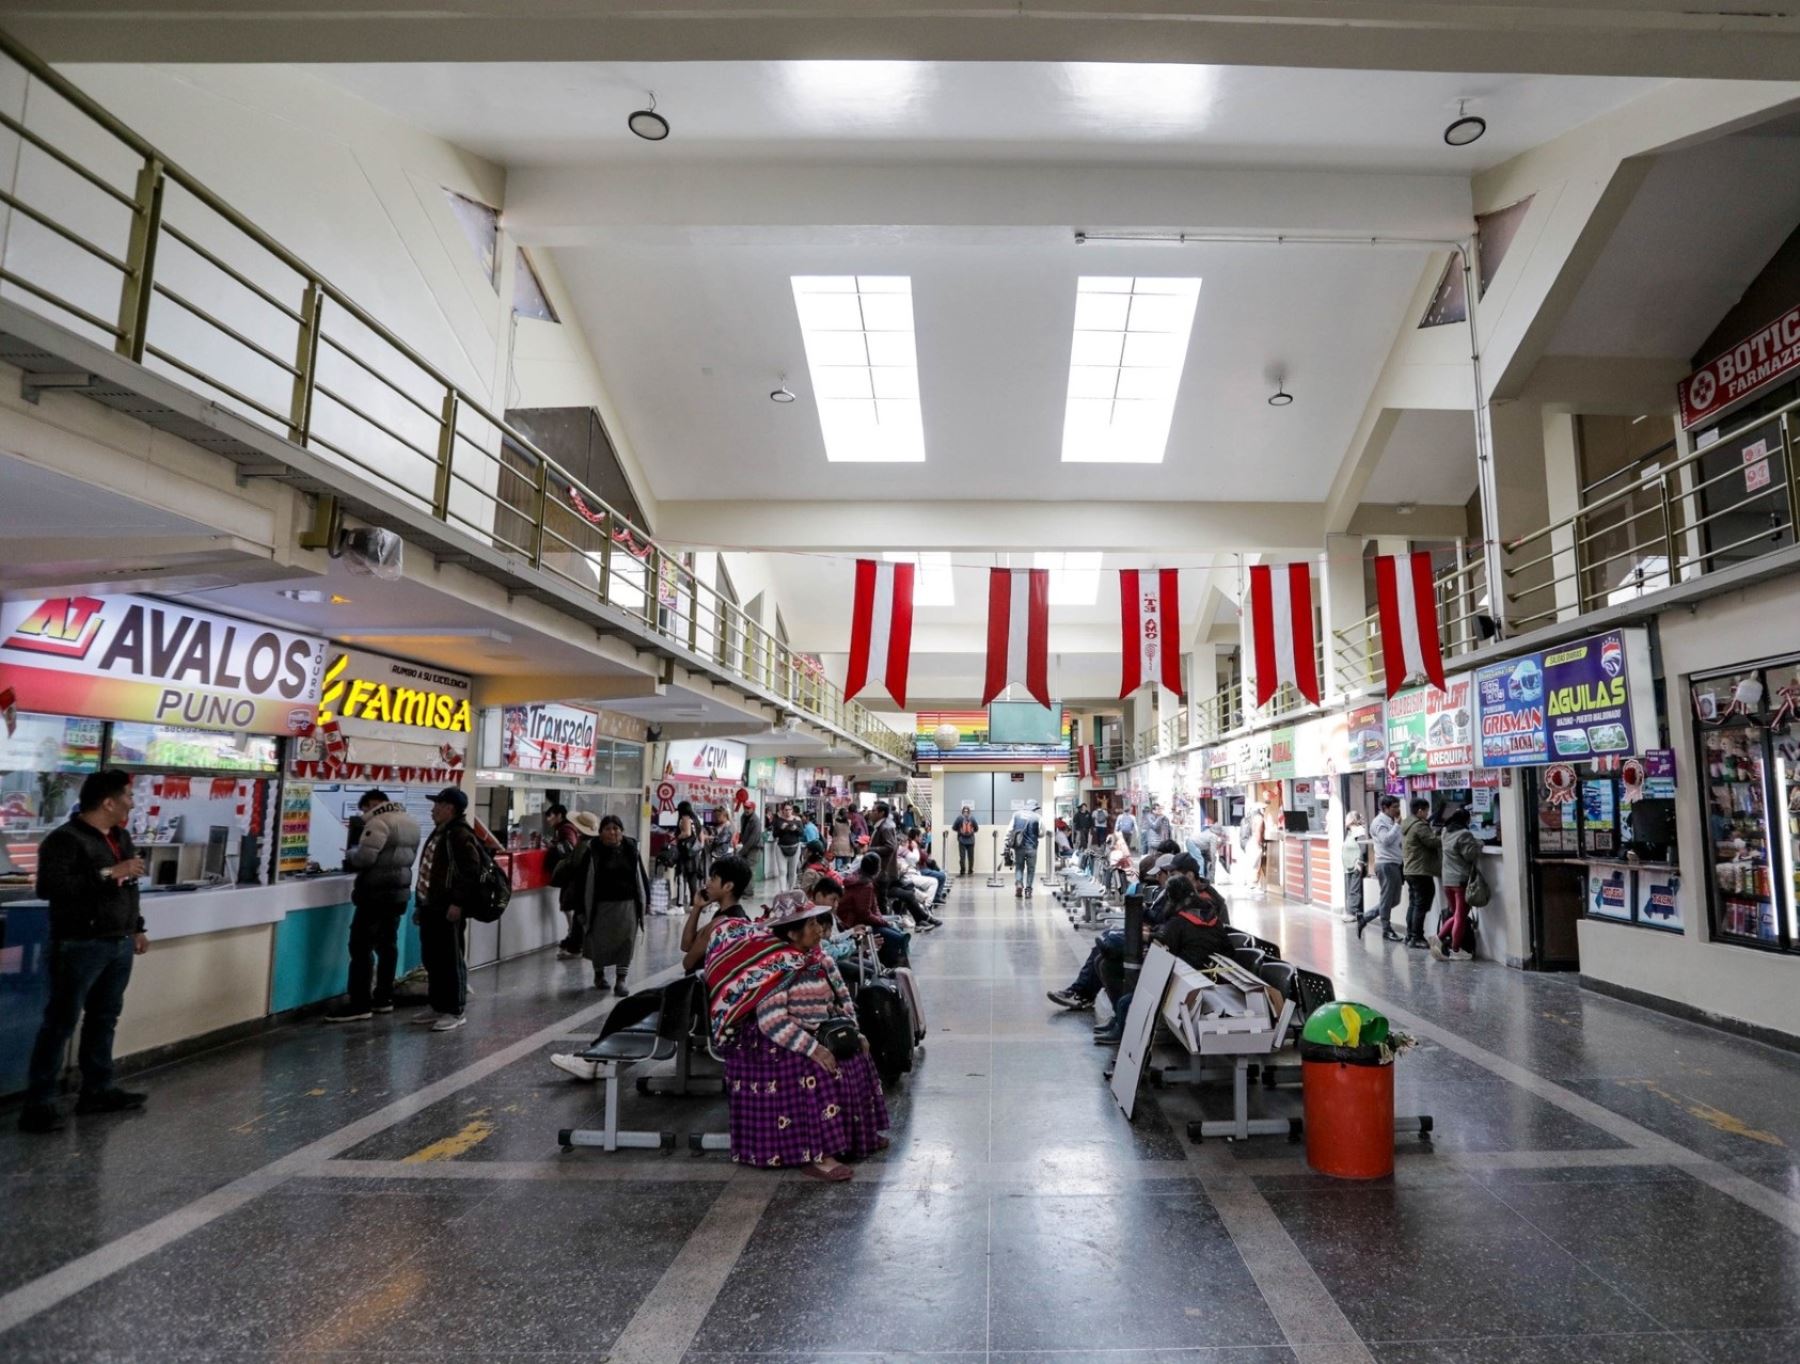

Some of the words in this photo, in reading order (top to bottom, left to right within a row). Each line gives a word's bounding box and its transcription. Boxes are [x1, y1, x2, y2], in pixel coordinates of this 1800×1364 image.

[98, 604, 311, 699] AVALOS
[1550, 652, 1565, 664] SALIDAS
[309, 643, 325, 700] TOURS
[392, 664, 417, 679] RUMBO
[424, 671, 432, 682] SU
[433, 674, 468, 689] EXCELENCIA
[156, 689, 256, 728] PUNO
[341, 679, 472, 733] FAMISA
[1548, 675, 1626, 717] AGUILAS
[529, 704, 593, 748] Transzela
[1482, 706, 1544, 737] GRISMAN
[1576, 713, 1593, 725] PUERTO
[1593, 709, 1621, 721] MALDONADO
[1389, 725, 1409, 744] LIMA
[1509, 734, 1533, 752] TACNA
[707, 746, 728, 768] CIVA
[1412, 775, 1434, 790] LIMA
